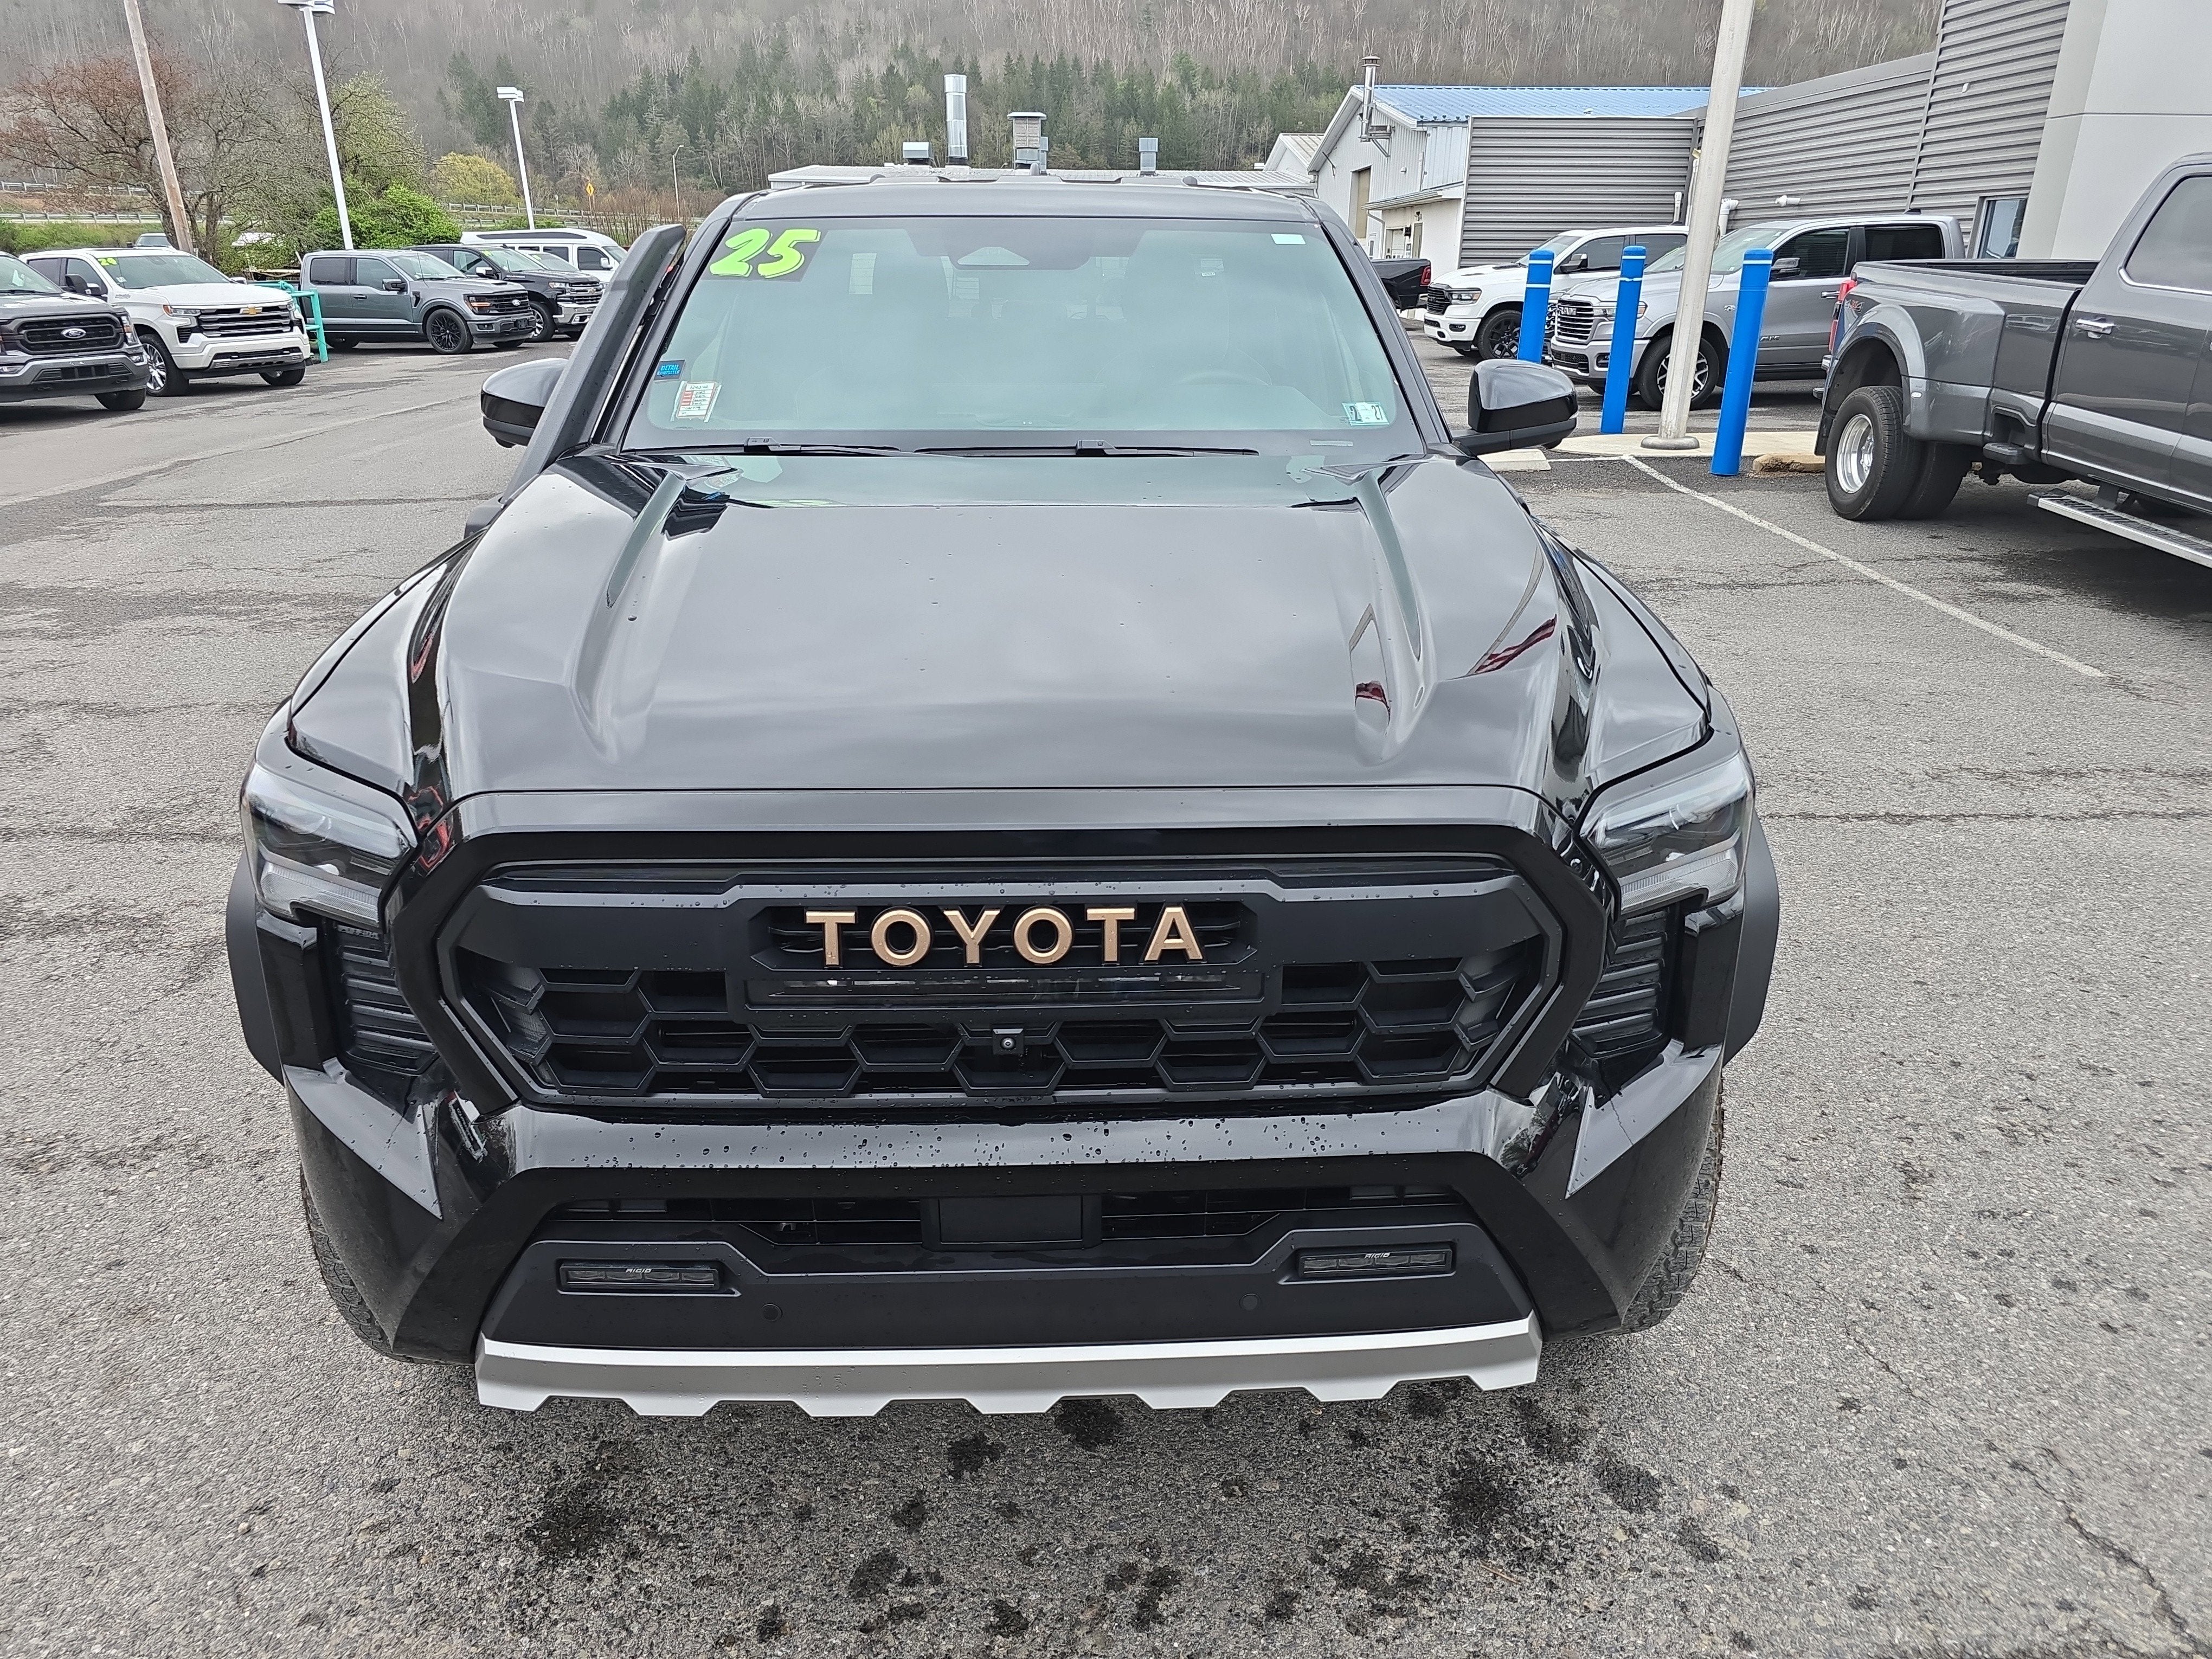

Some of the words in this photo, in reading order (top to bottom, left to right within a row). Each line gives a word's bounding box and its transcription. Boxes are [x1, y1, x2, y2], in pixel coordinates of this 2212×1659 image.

[709, 228, 822, 279] 25
[1371, 405, 1383, 420] 27
[805, 906, 1205, 966] TOYOTA
